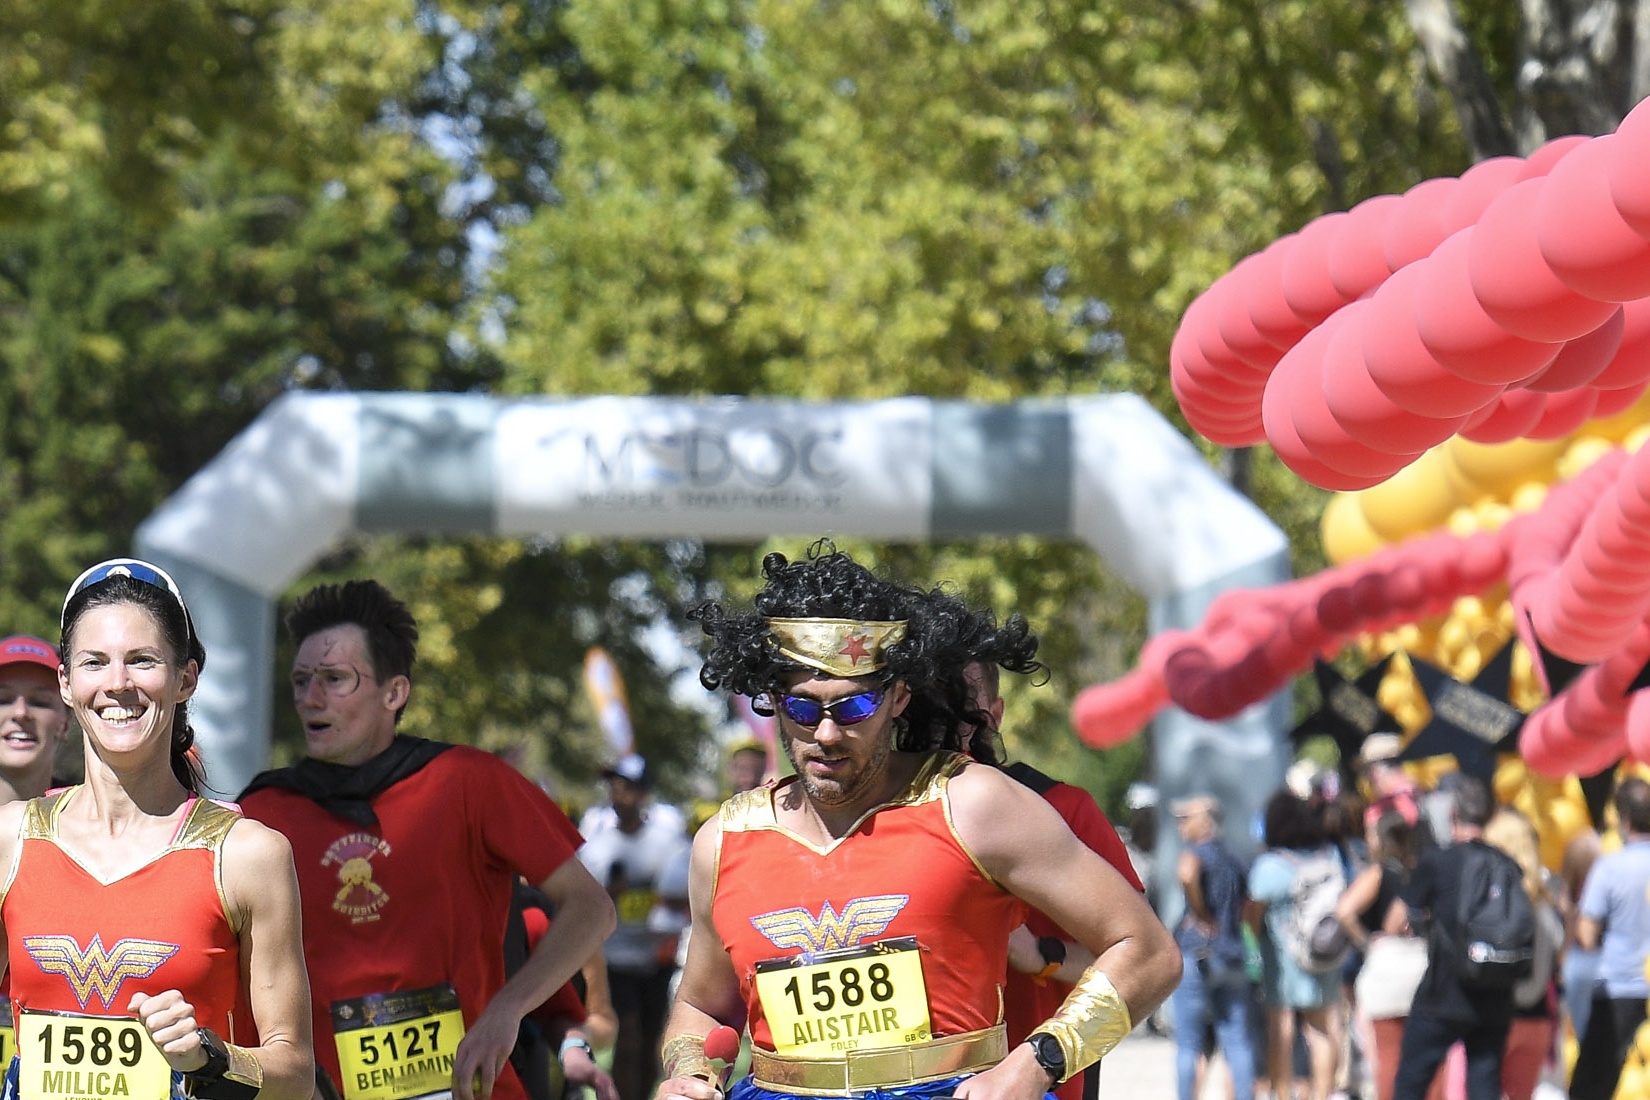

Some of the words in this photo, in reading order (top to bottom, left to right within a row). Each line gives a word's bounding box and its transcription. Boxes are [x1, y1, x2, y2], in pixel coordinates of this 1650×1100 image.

[784, 962, 894, 1016] 1588
[38, 1024, 143, 1067] 1589
[359, 1020, 441, 1066] 5127
[792, 1007, 900, 1046] ALISTAIR
[831, 1039, 859, 1052] FOLEY
[42, 1070, 129, 1096] MILICA
